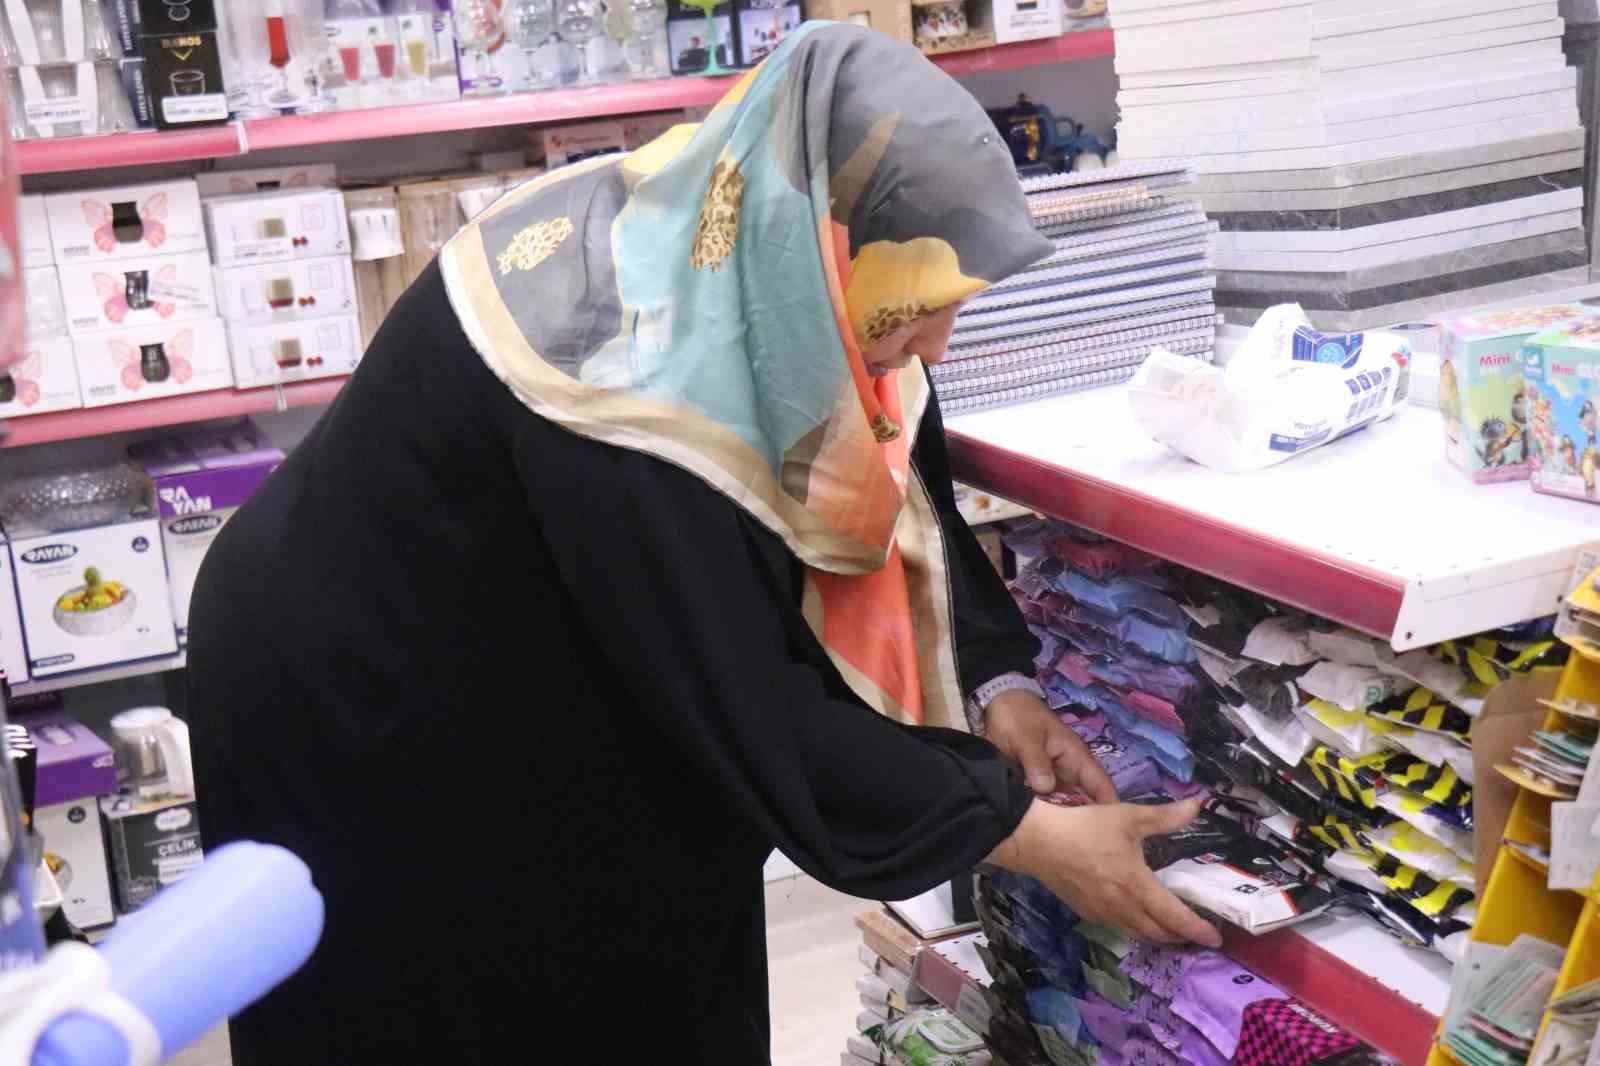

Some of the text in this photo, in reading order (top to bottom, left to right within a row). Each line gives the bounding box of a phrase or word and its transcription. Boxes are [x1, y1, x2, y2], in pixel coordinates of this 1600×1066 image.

[1480, 352, 1511, 367] Mini
[172, 496, 212, 515] YAN
[25, 544, 75, 563] RAYAN
